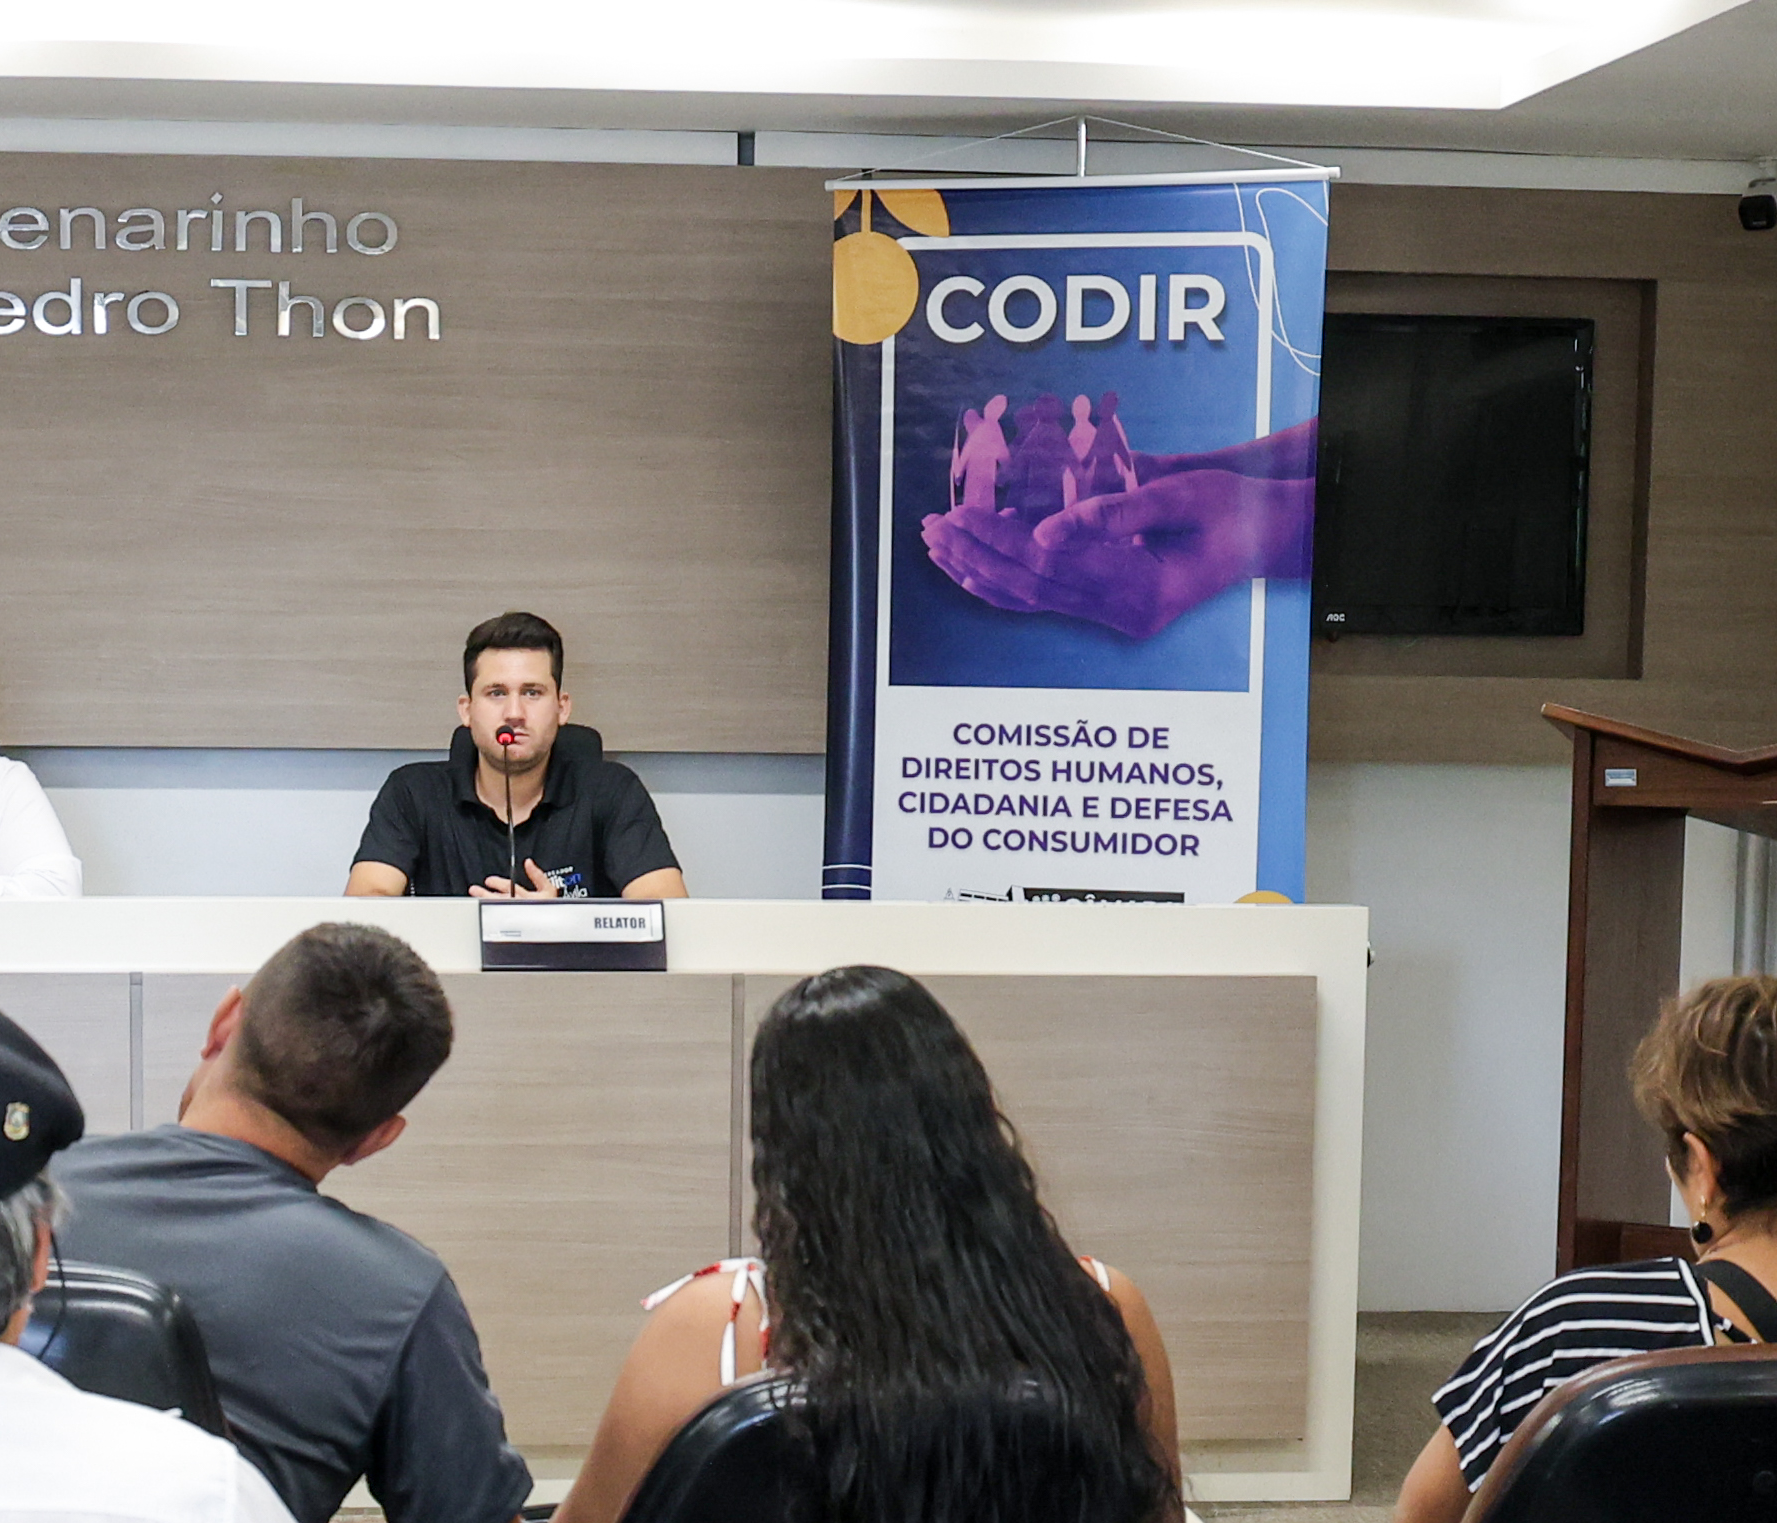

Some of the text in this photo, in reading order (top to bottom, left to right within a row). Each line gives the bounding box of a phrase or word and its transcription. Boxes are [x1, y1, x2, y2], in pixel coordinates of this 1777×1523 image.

[210, 278, 440, 340] Thon
[926, 274, 1226, 343] CODIR
[953, 720, 1170, 749] COMISSÃO DE
[901, 757, 1223, 790] DIREITOS HUMANOS,
[898, 791, 1233, 822] CIDADANIA E DEFESA
[928, 827, 1200, 856] DO CONSUMIDOR
[594, 917, 646, 929] RELATOR
